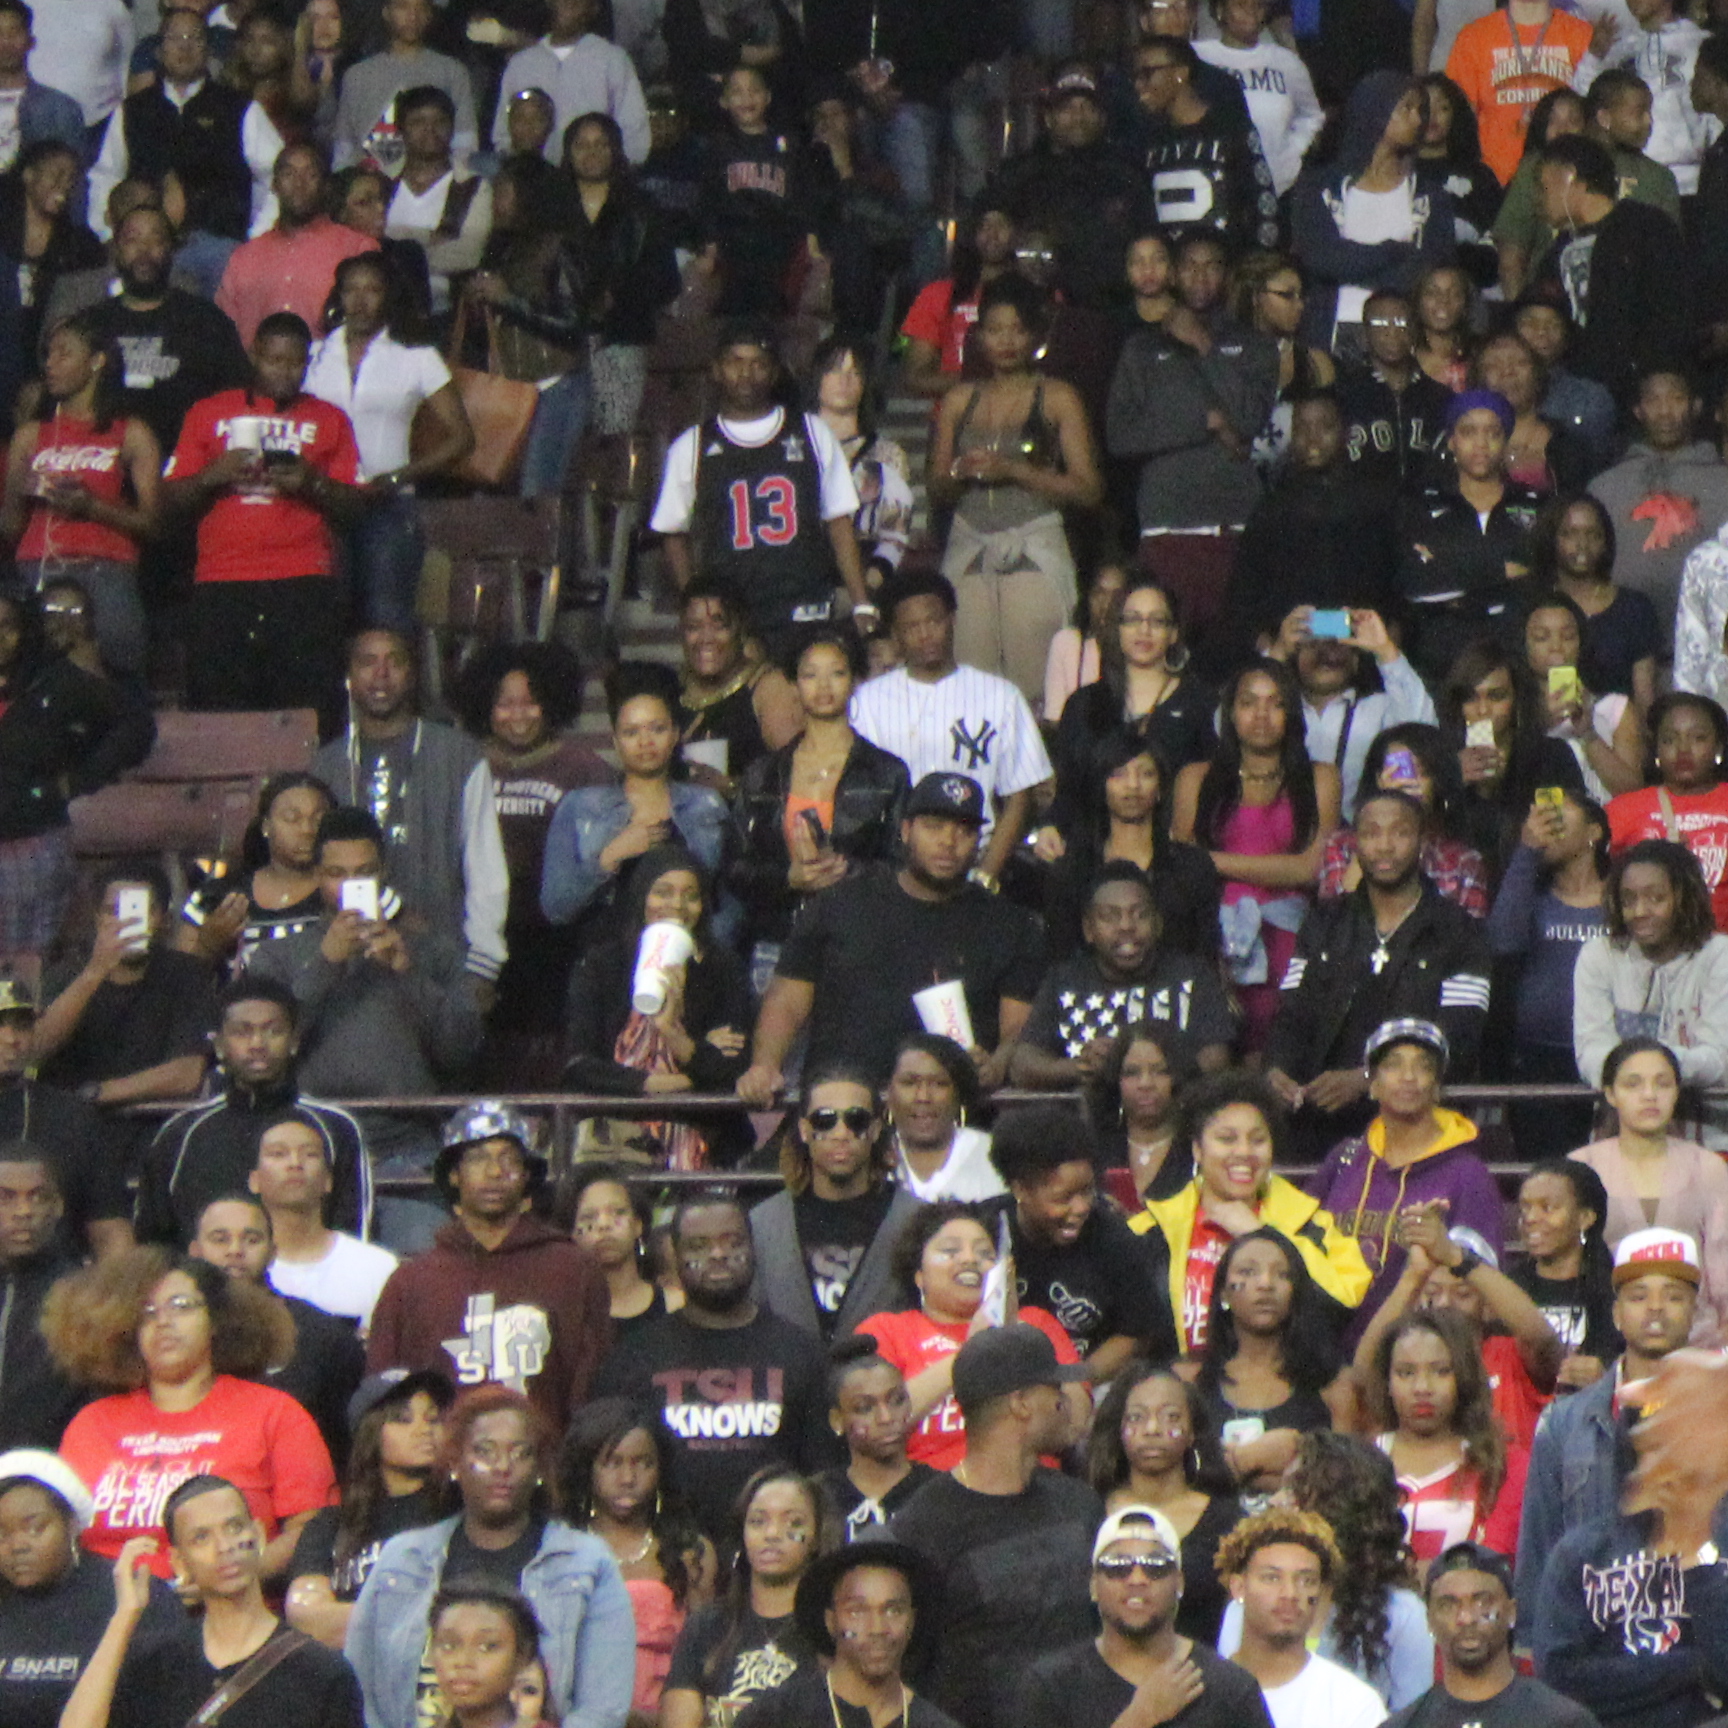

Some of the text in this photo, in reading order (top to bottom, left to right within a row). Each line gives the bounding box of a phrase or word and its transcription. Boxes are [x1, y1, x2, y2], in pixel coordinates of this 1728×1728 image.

[1232, 66, 1287, 95] AMU
[1347, 417, 1446, 462] POL
[728, 475, 798, 551] 13
[948, 718, 998, 770] NY
[652, 1368, 784, 1405] TSU
[664, 1403, 784, 1438] KNOWS
